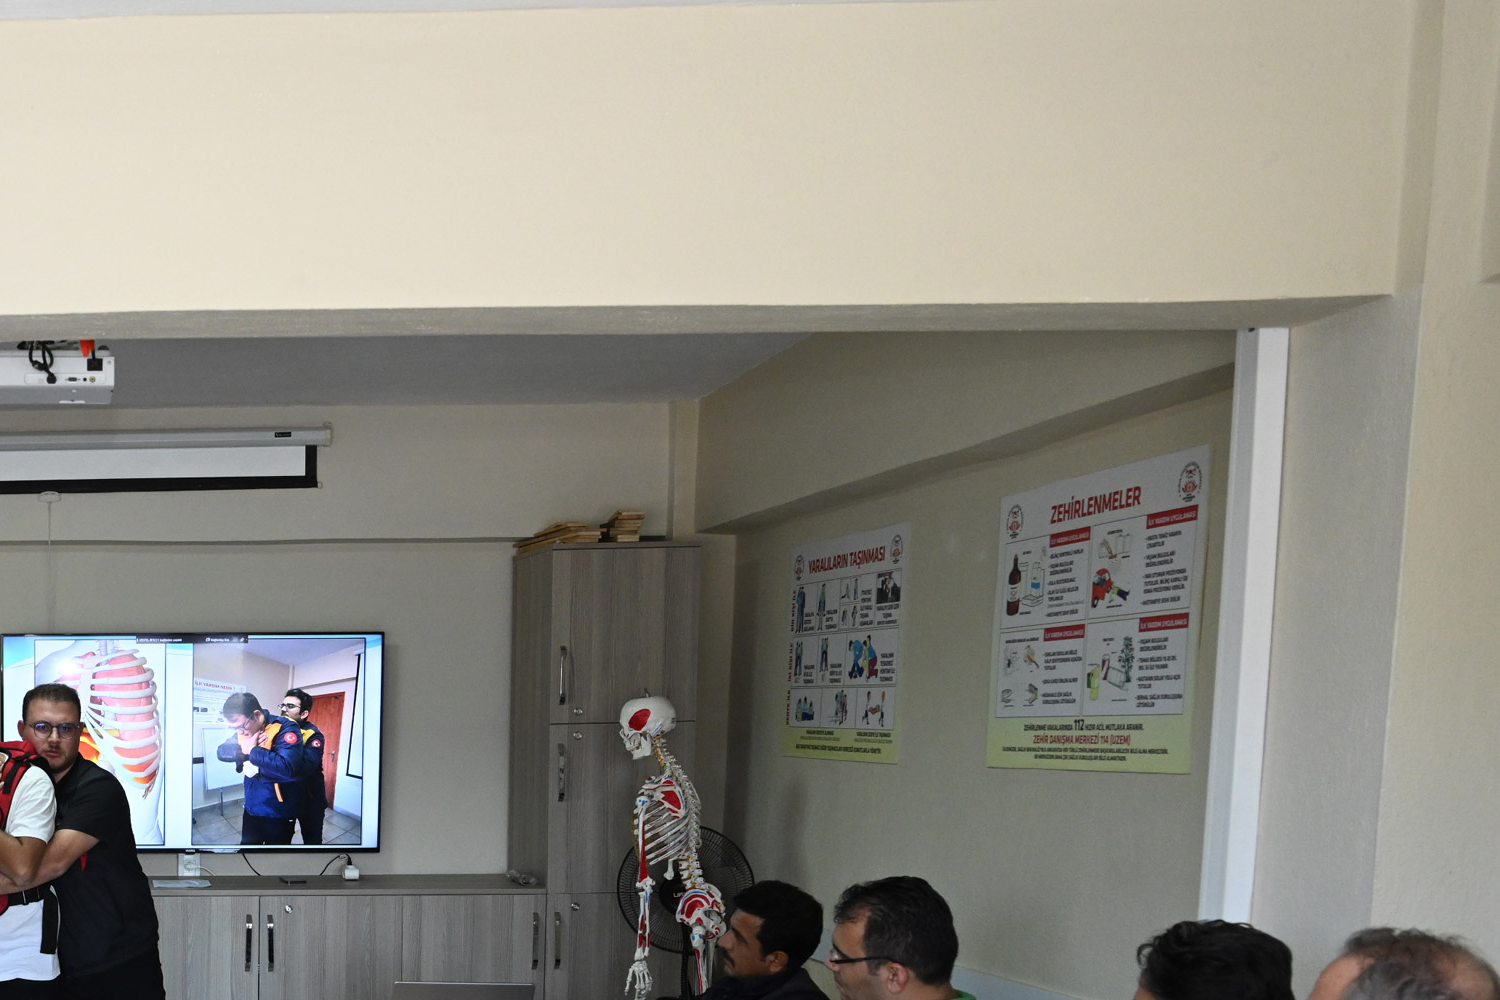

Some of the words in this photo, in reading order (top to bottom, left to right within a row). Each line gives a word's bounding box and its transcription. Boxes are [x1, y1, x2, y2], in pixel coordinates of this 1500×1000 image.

[1050, 486, 1142, 524] ZEHİRLENMELER
[808, 555, 848, 574] YARALILARIN
[849, 546, 886, 568] TAŞINMASI
[1073, 719, 1085, 731] 112
[1033, 732, 1049, 744] ZEHİR
[1049, 735, 1074, 746] DANIŞMA
[1075, 732, 1100, 744] MERKEZİ
[1100, 735, 1109, 744] 114
